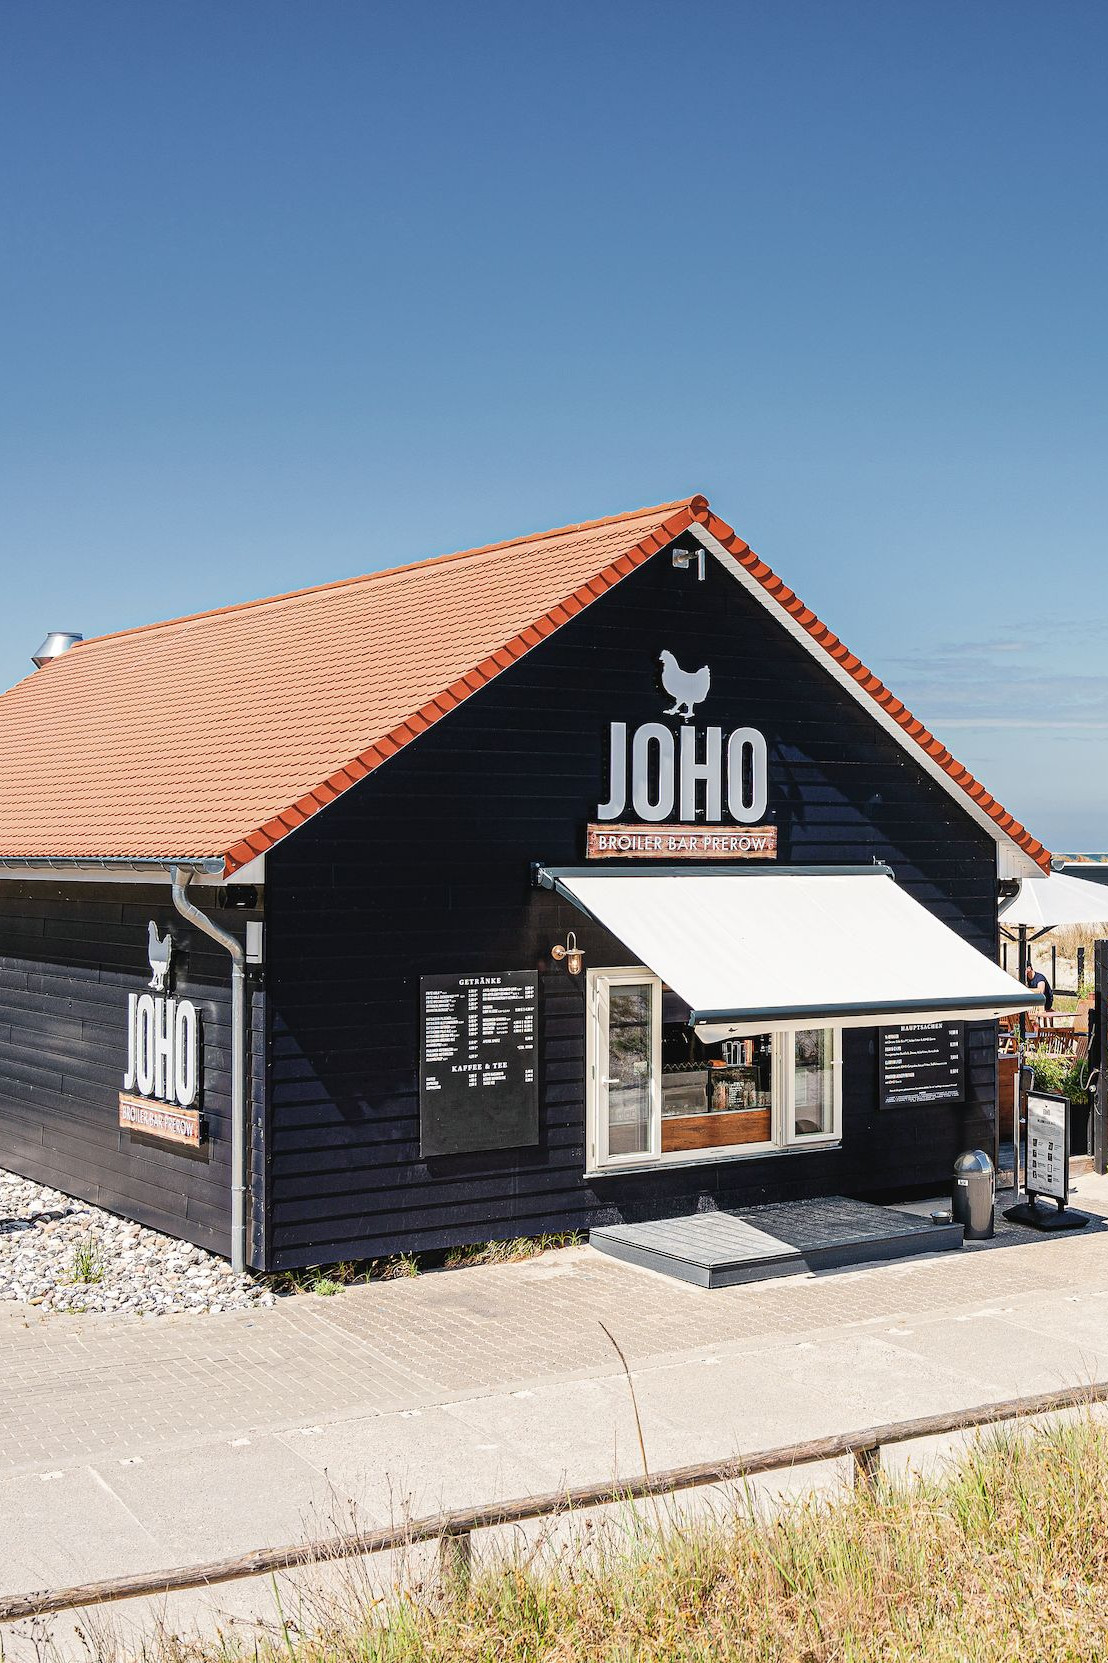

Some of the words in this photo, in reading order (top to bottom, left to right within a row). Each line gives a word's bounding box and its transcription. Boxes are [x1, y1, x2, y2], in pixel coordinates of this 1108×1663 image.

[597, 721, 768, 823] JOHO
[599, 835, 662, 850] BROILER
[668, 837, 697, 851] BAR
[704, 837, 767, 851] PREROW
[459, 977, 502, 985] GETRÄNKE
[900, 1023, 943, 1031] HAUPTSACHEN
[124, 993, 197, 1106] JOHO
[451, 1063, 483, 1072] KAFFEE
[484, 1062, 491, 1070] &
[492, 1061, 508, 1069] TEE
[122, 1105, 149, 1125] BROILER
[164, 1115, 194, 1137] PREROW
